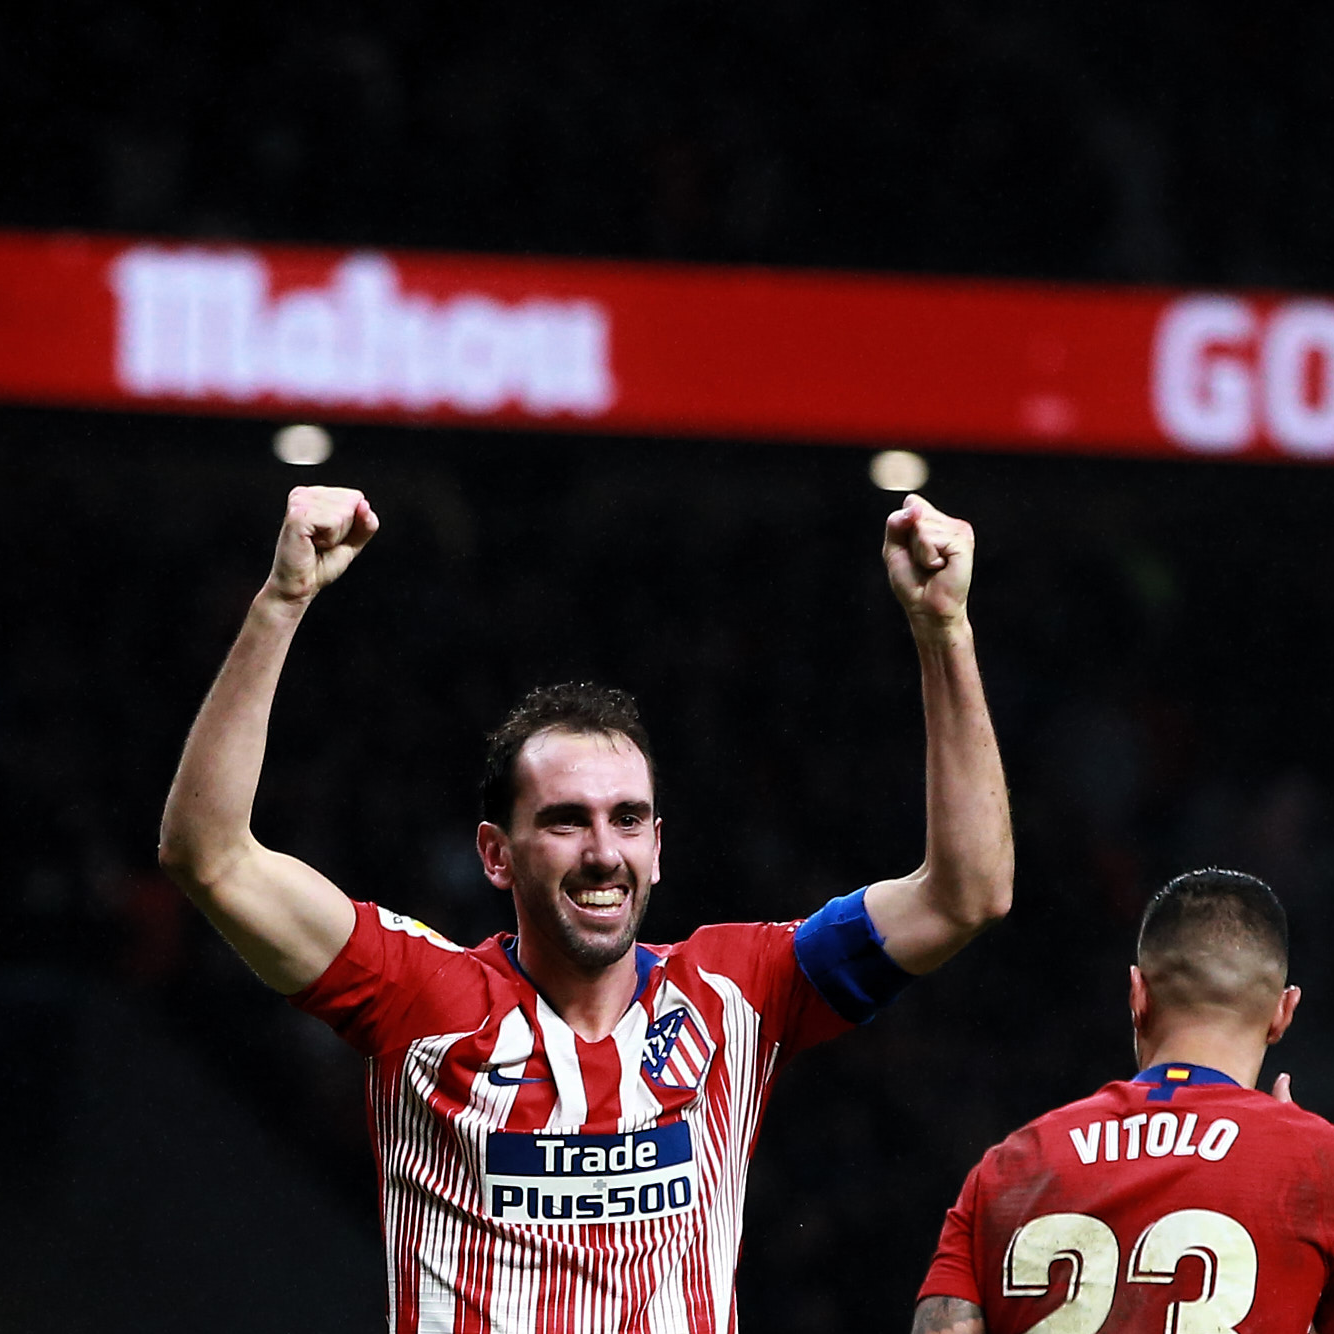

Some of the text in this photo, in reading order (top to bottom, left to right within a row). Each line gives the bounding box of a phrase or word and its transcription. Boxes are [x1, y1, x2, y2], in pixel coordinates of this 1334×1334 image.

[113, 247, 613, 415] Mahou
[536, 1135, 657, 1173] Trade
[1069, 1111, 1240, 1165] VITOLO
[492, 1175, 692, 1220] Plus500
